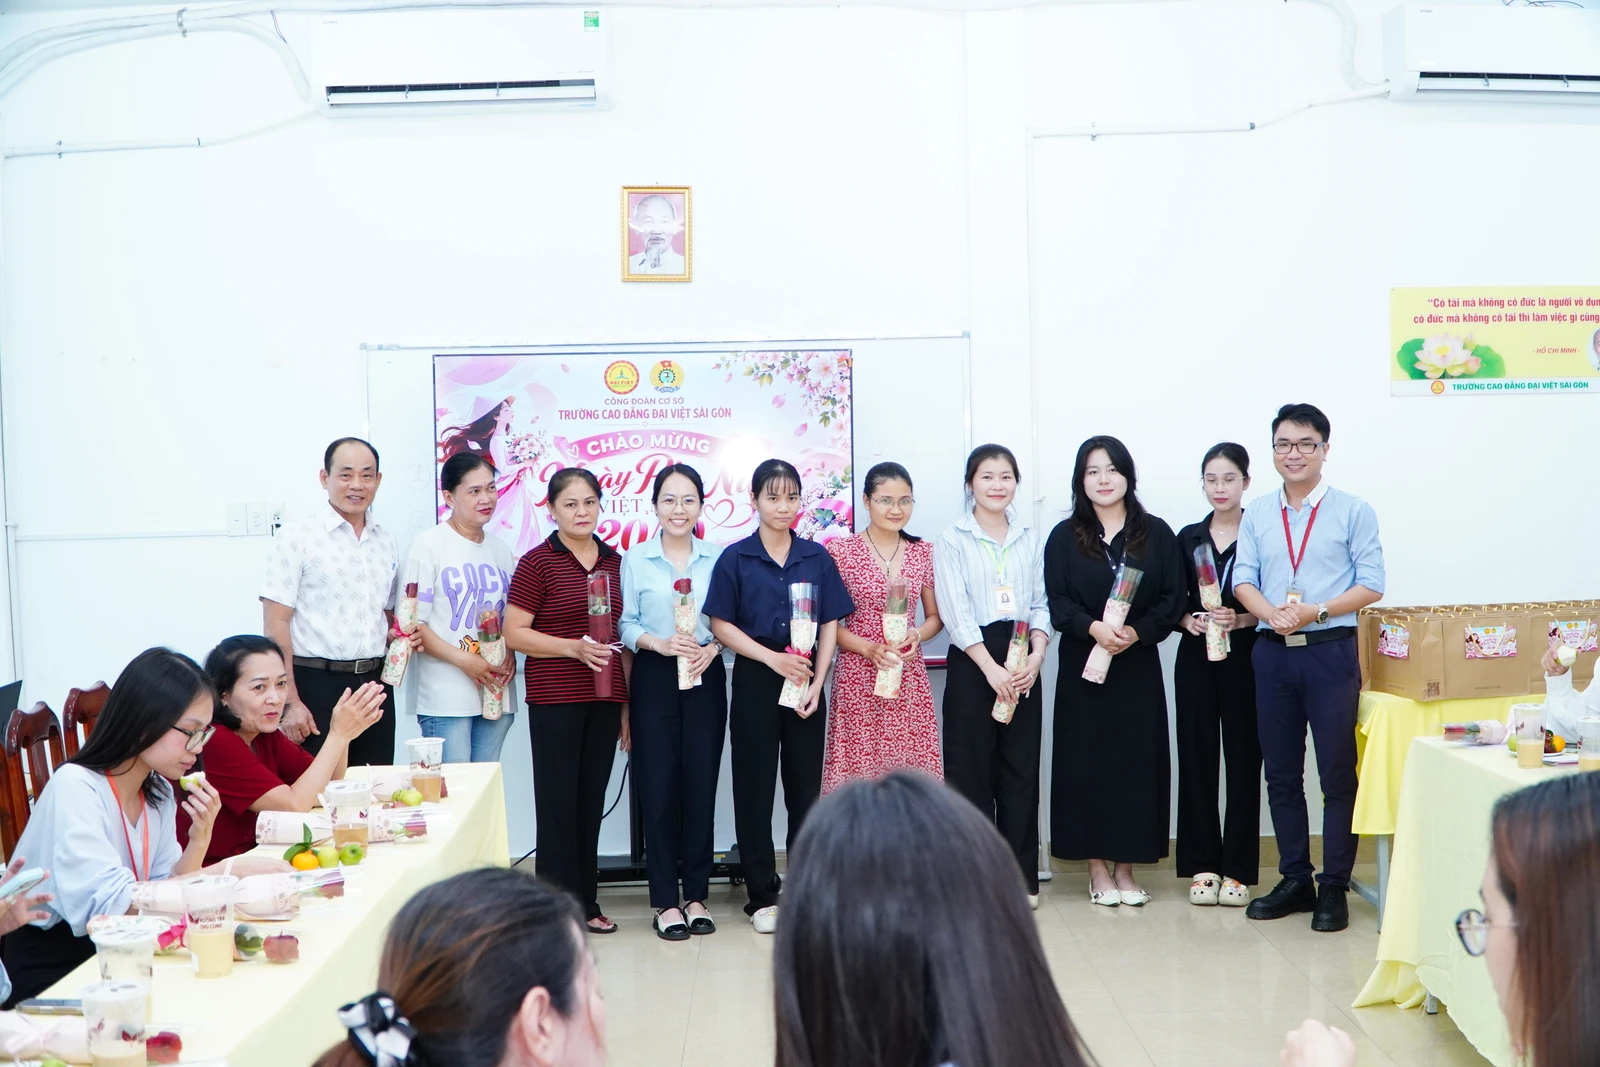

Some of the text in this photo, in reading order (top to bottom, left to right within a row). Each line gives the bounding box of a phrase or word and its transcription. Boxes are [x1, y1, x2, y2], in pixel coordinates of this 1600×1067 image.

[1448, 297, 1460, 308] tài
[1462, 297, 1476, 308] mà
[1478, 297, 1505, 309] không
[1507, 296, 1518, 307] có
[1520, 296, 1536, 307] đức
[1538, 296, 1547, 307] là
[1549, 296, 1572, 309] người
[1574, 296, 1584, 307] vô
[1413, 312, 1600, 325] có đức mà không có tài thì làm việc gì cũng
[1452, 383, 1486, 391] TRƯỜNG
[1503, 380, 1526, 390] ĐẲNG
[1527, 382, 1541, 391] ĐẠI
[1542, 381, 1558, 391] VIỆT
[1559, 381, 1572, 389] SÀI
[1573, 380, 1589, 389] GÒN
[604, 395, 685, 406] CÔNG ĐOÀN CƠ SỞ
[558, 406, 732, 422] TRƯỜNG CAO ĐẲNG ĐẠI VIỆT SÀI GÒN
[586, 431, 711, 456] CHÀO MỪNG
